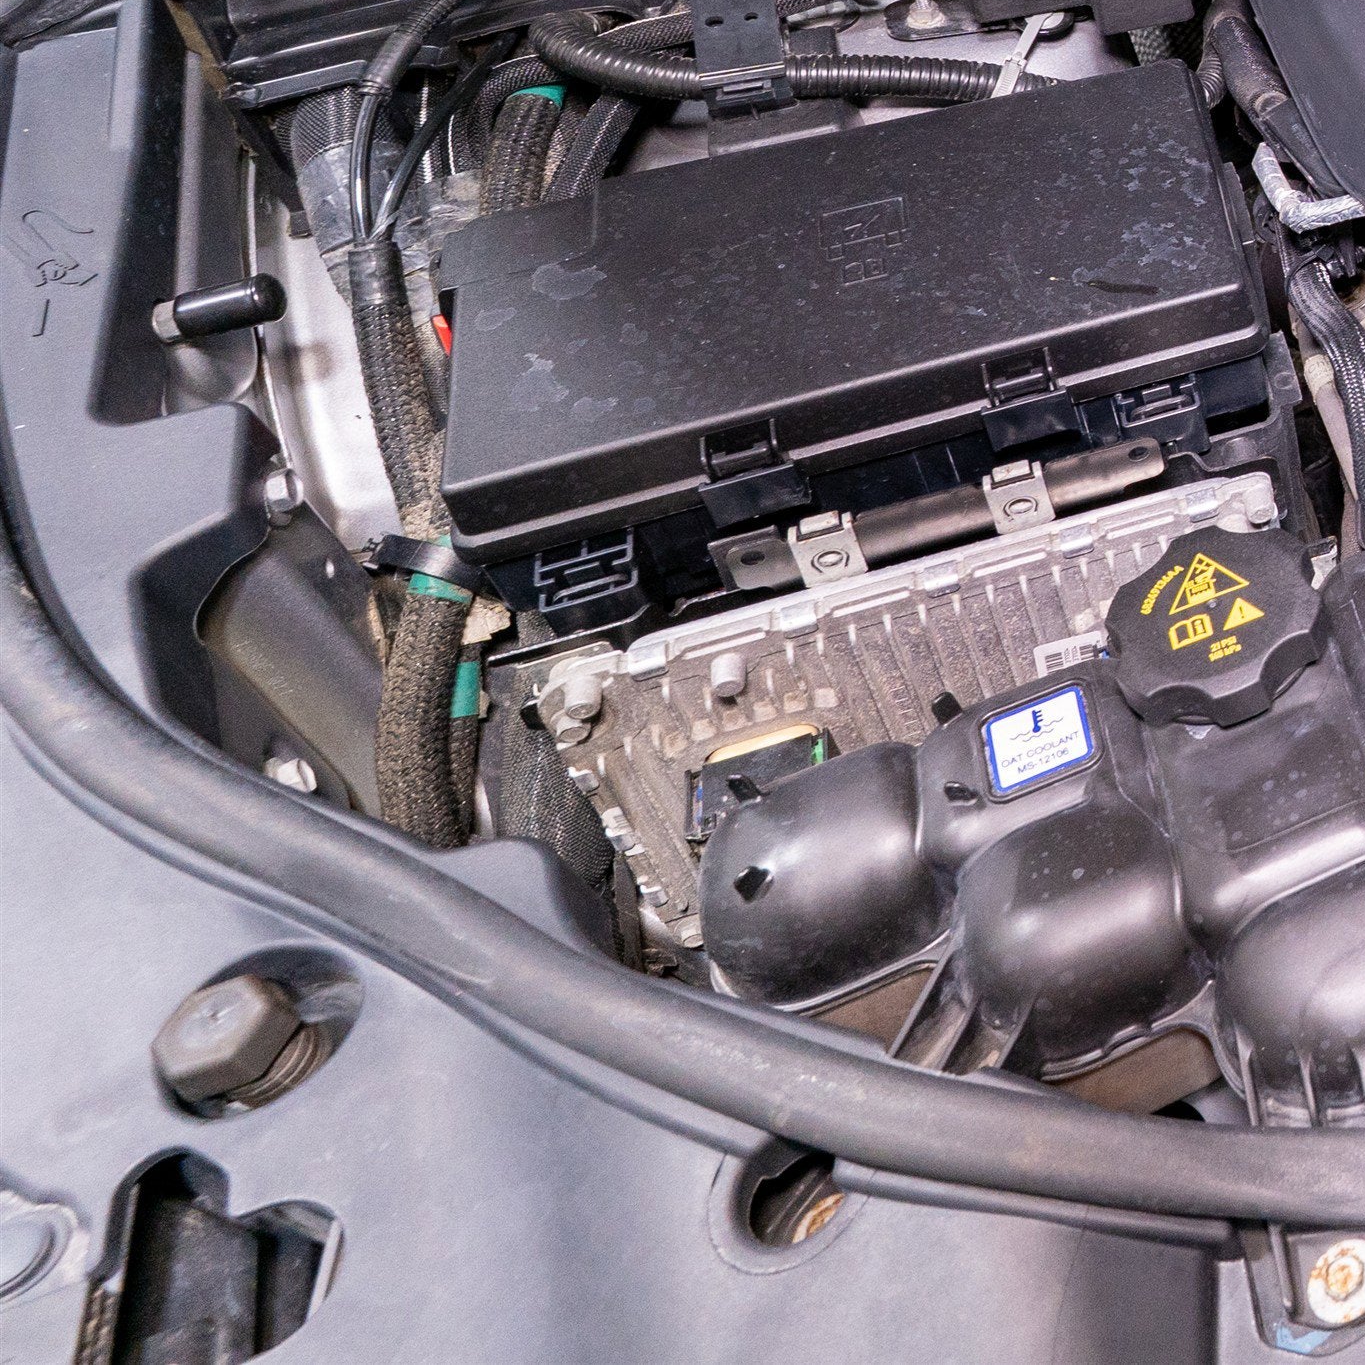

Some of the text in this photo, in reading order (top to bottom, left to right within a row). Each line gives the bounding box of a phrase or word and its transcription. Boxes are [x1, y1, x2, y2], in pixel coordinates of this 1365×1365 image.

[1001, 730, 1080, 769] OAT COOLANT
[1017, 747, 1070, 775] MS-12106
